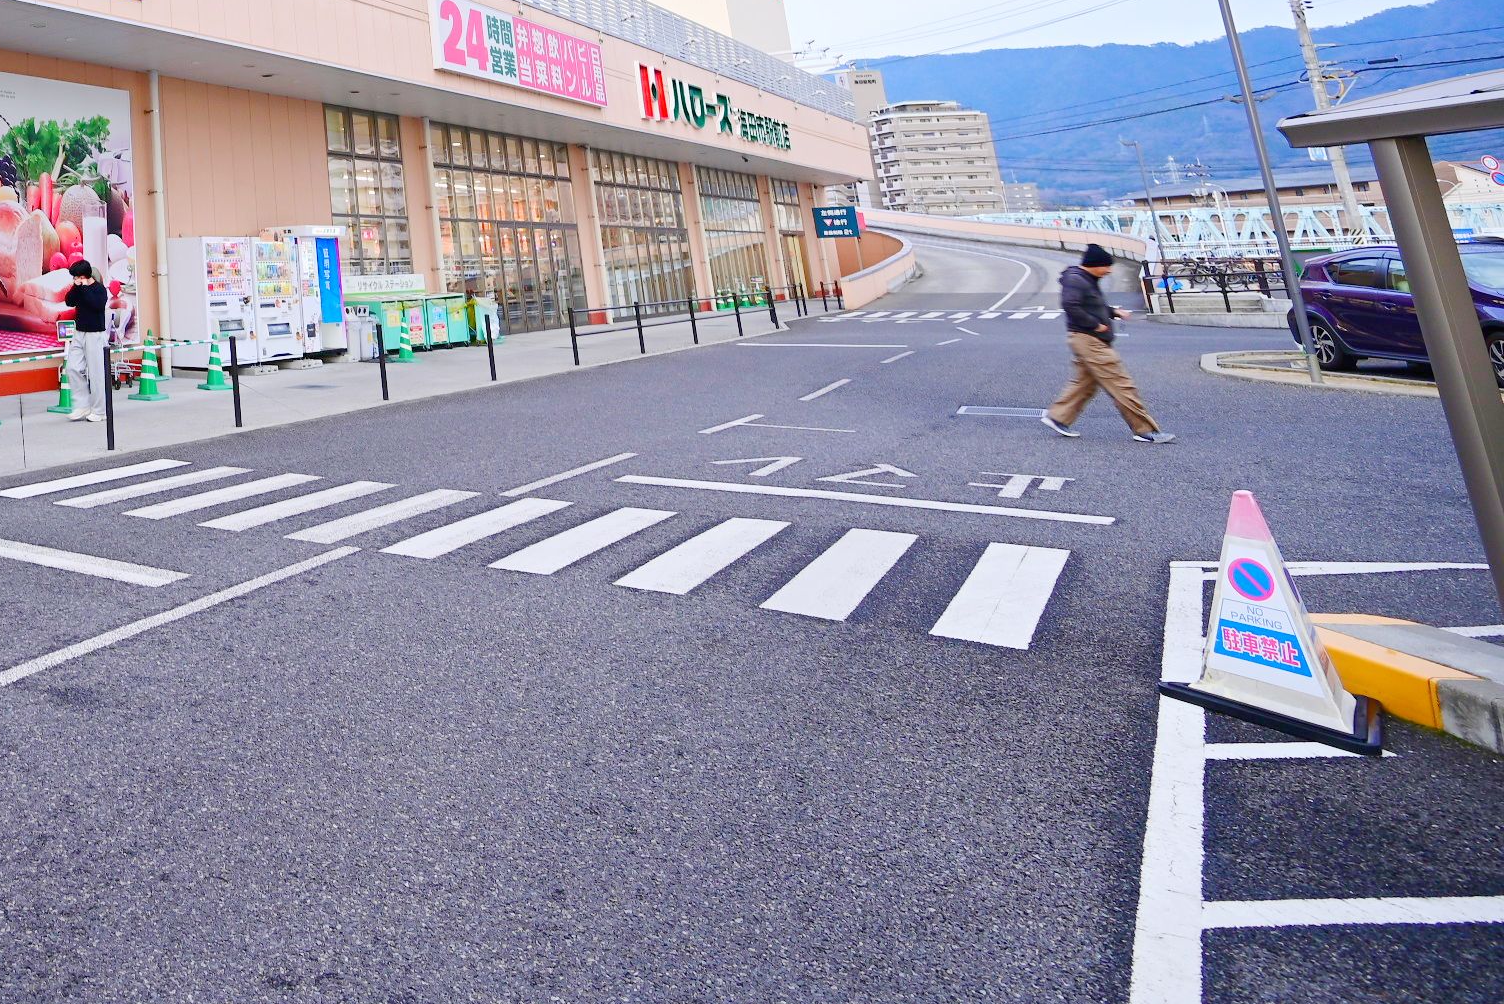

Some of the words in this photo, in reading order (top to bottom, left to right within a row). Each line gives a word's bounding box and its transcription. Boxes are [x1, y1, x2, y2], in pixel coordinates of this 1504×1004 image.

[439, 0, 489, 71] 24
[486, 14, 513, 49] 時間
[489, 46, 517, 79] 営業
[515, 24, 533, 84] 弁当
[547, 33, 564, 91] 飲料
[563, 38, 577, 93] パン
[576, 43, 592, 97] ビール
[591, 48, 606, 102] 日用品
[669, 77, 739, 135] ハローズ
[1230, 611, 1283, 631] PARKING
[1246, 605, 1264, 617] NO
[1221, 626, 1301, 668] 駐車禁止
